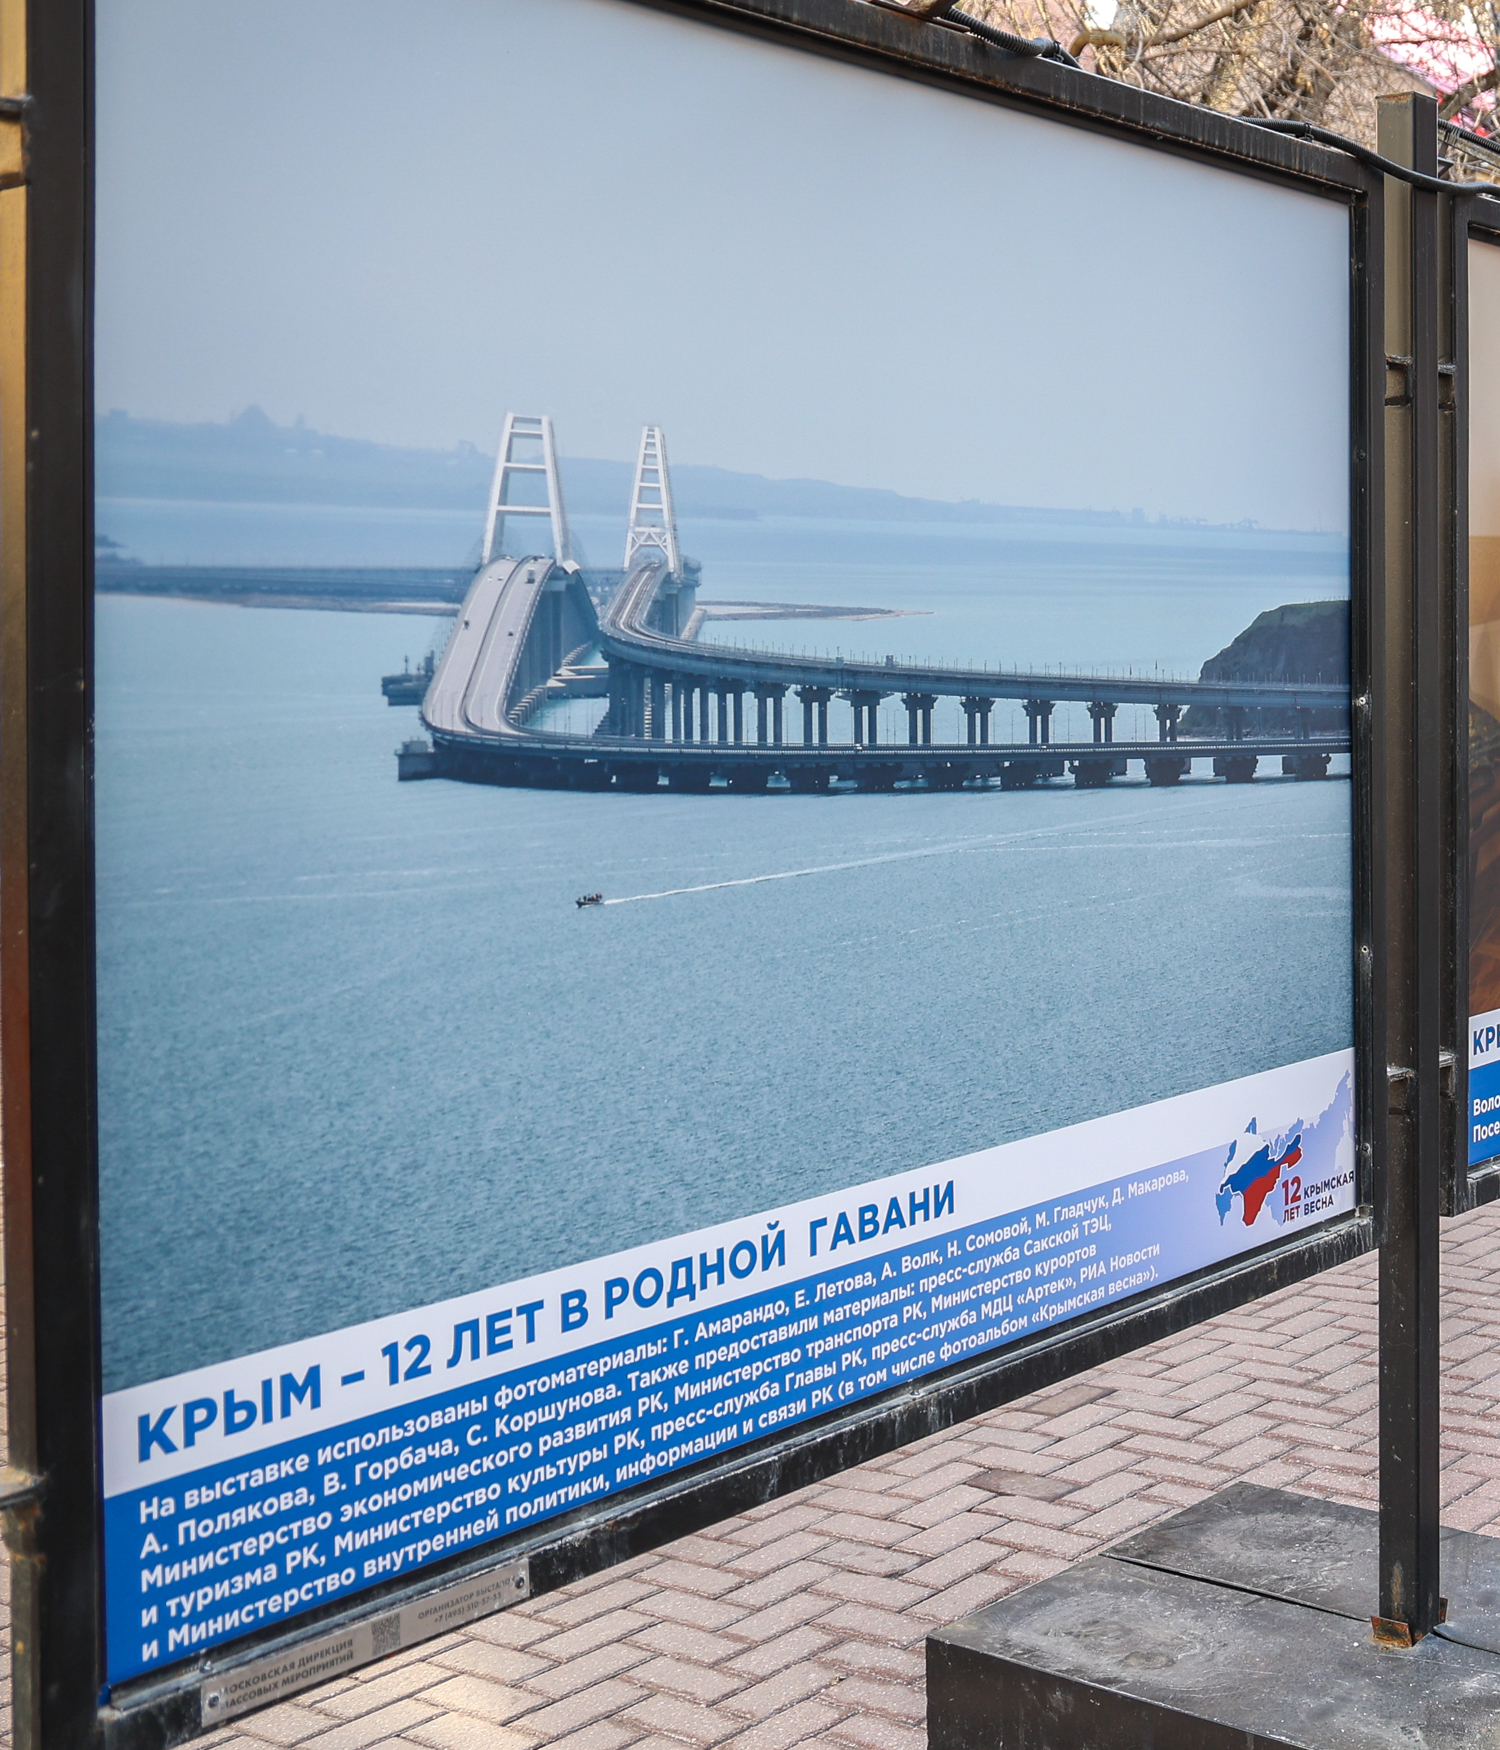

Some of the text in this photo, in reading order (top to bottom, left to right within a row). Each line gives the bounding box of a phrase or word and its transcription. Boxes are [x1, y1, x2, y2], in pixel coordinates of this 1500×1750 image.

[1282, 1170, 1354, 1206] 12 КРЫМСКАЯ
[1283, 1194, 1334, 1223] ЛЕТ ВЕСНА
[138, 1364, 321, 1463] КРЫМ
[381, 1334, 431, 1386] 12
[446, 1299, 544, 1368] ЛЕТ
[561, 1289, 588, 1333] В
[604, 1220, 785, 1320] РОДНОЙ
[809, 1180, 954, 1257] ГАВАНИ
[139, 1169, 1189, 1524] На выставке использованы фотоматериалы: Г. Амарандо, Е. Летова, А. Волк, Н. Сомовой, М. Гладчук, Д. Макарова,
[140, 1213, 1111, 1559] А. Полякова, В. Горбача, С. Коршунова. Также предоставили материалы: пресс-служба Сакской ТЭЦ,
[141, 1244, 1096, 1593] Министерство экономического развития РК, Министерство транспорта РК, Министерство курортов
[141, 1243, 1160, 1627] и туризма РК, Министерство культуры РК, пресс-служба Главы РК, пресс-служба МДЦ «Артек», РИА Новости
[142, 1264, 1158, 1662] и Министерство внутренней политики, информации и связи РК (в том числе фотоальбом «Крымская весна»).
[281, 1650, 354, 1687] МЕРОПРИЯТИЙ
[298, 1639, 353, 1669] ДИРЕКЦИЯ
[418, 1593, 474, 1620] ОРГАНИЗАТОР
[445, 1607, 465, 1622] (495)
